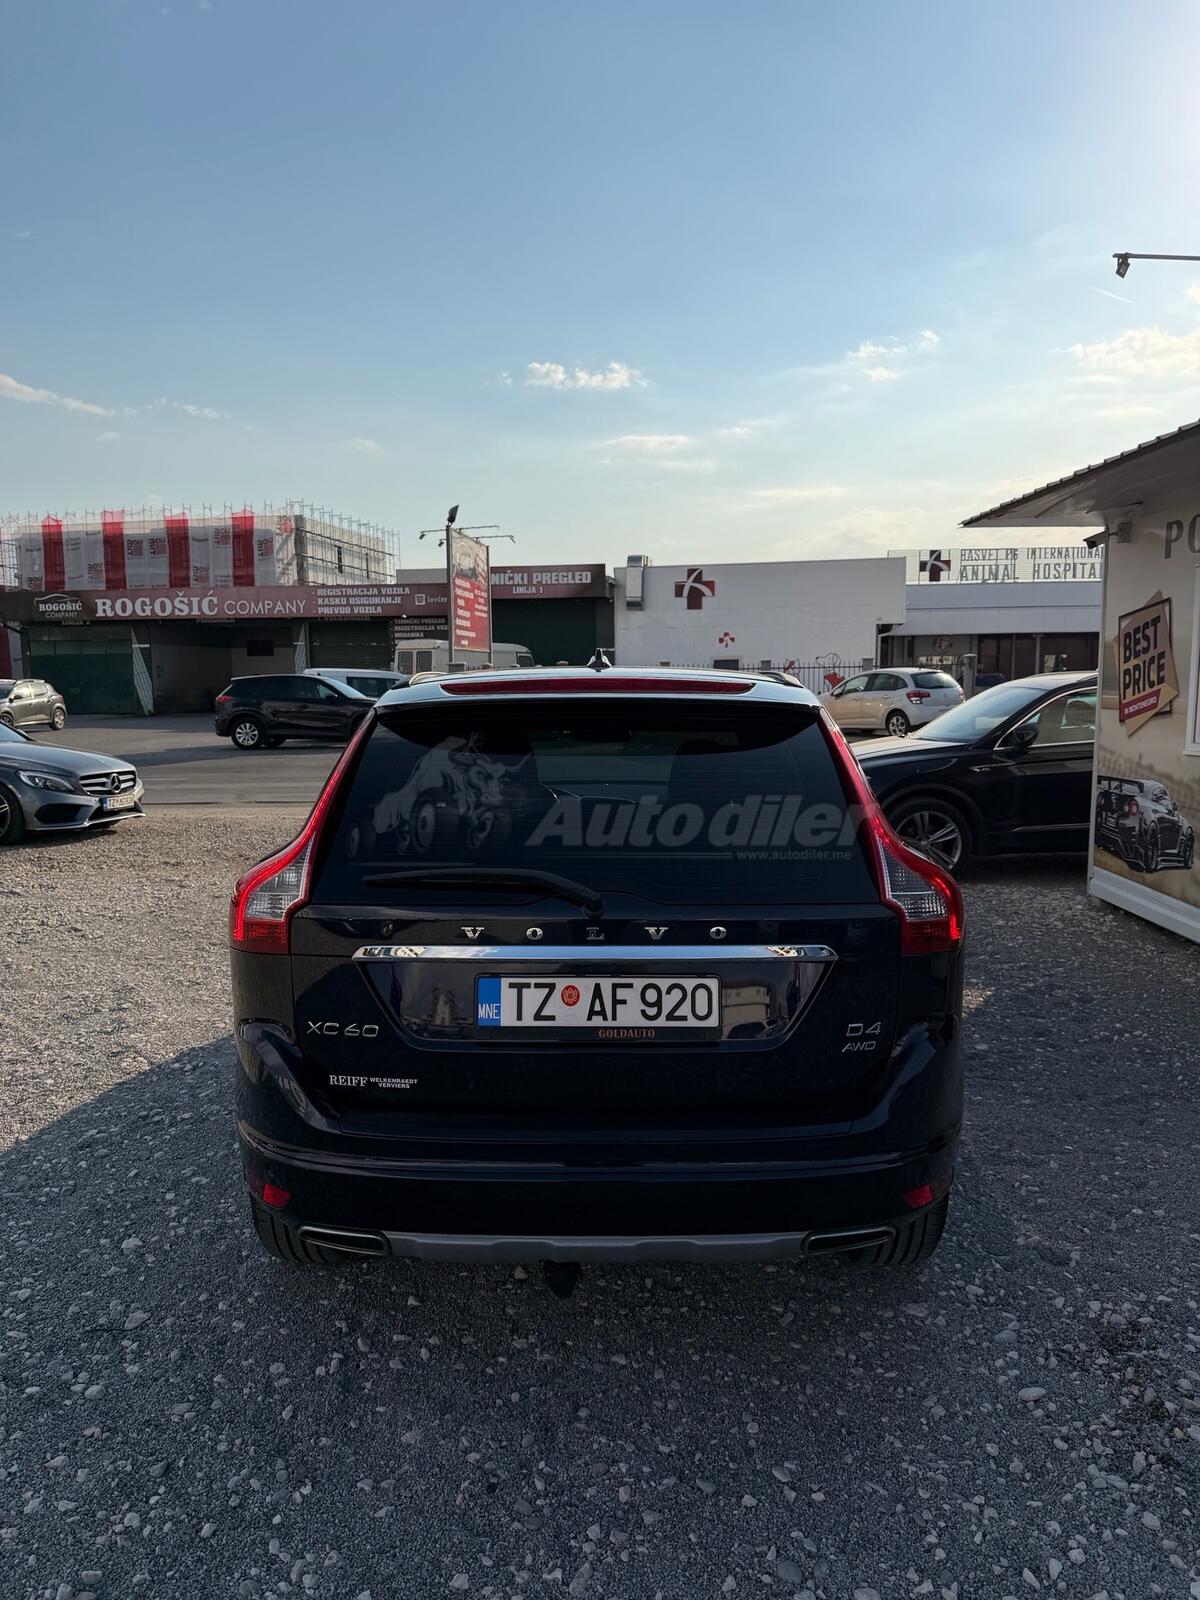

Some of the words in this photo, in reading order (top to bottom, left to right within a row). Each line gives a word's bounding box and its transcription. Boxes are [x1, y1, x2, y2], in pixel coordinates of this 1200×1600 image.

[533, 571, 592, 585] PREGLED
[960, 564, 1020, 581] ANIMAL
[317, 588, 378, 596] REGISTRACIJA
[381, 587, 410, 595] VOZILA
[39, 600, 82, 611] ROGOŠIĆ
[95, 590, 218, 617] ROGOŠIĆ
[224, 600, 306, 615] COMPANY
[317, 597, 347, 605] KASKO
[350, 596, 402, 604] OSIGURANJE
[318, 606, 351, 614] PREVOD
[354, 606, 382, 614] VOZILA
[1123, 615, 1161, 665] BEST
[1122, 650, 1166, 700] PRICE
[1129, 696, 1158, 713] MONTENEGRO
[460, 926, 728, 941] VOLVO
[478, 1003, 501, 1019] MNE
[508, 982, 557, 1022] TZ
[598, 1028, 656, 1039] GOLDAUTO
[846, 1021, 882, 1037] D4
[841, 1040, 877, 1053] AWD
[329, 1074, 368, 1087] REIFF
